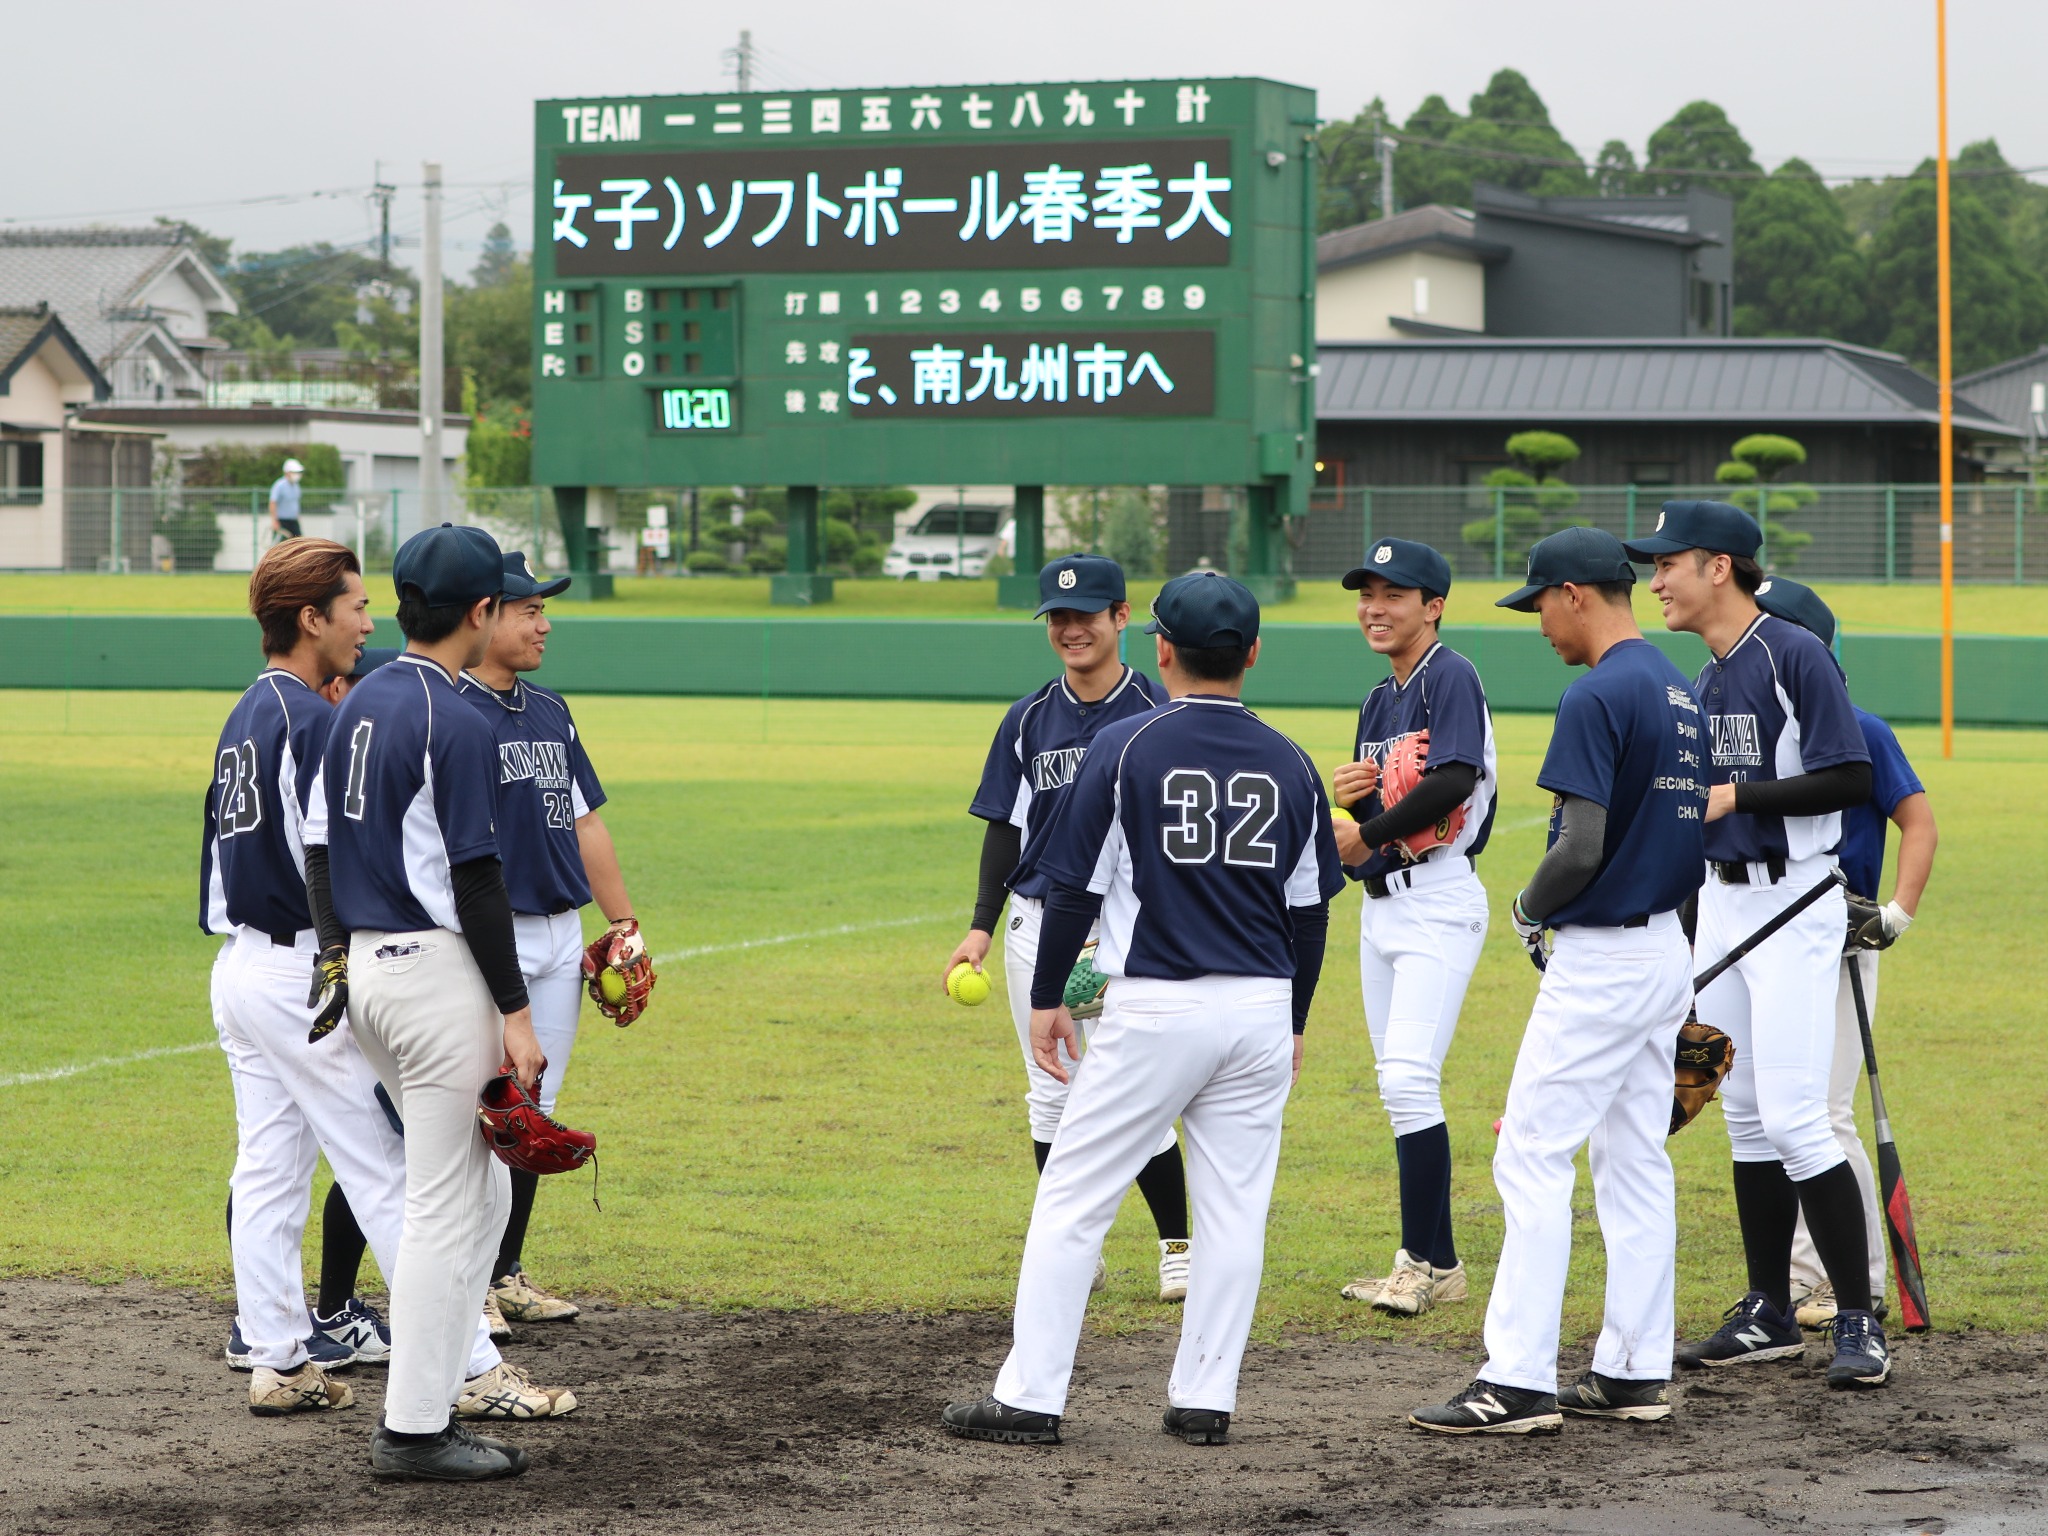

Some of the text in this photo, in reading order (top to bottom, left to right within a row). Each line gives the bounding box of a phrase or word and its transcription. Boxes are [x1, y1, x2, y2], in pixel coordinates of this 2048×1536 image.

[562, 105, 641, 143] TEAM
[761, 100, 792, 134] 三
[811, 98, 841, 133] 四
[861, 97, 892, 131] 五
[910, 94, 942, 129] 六
[961, 93, 993, 129] 七
[1010, 91, 1044, 127] 八
[1063, 89, 1095, 126] 九
[1176, 85, 1211, 123] 計
[544, 291, 565, 313] H
[624, 289, 643, 312] B
[865, 290, 878, 314] 1
[900, 289, 922, 314] 2
[938, 288, 960, 314] 3
[979, 288, 1001, 313] 4
[1020, 287, 1041, 312] 5
[1061, 287, 1083, 312] 6
[1102, 286, 1123, 311] 7
[1142, 285, 1165, 310] 8
[1183, 284, 1206, 310] 9
[545, 323, 564, 345] E
[625, 321, 644, 344] S
[344, 719, 373, 822] 1
[217, 738, 262, 841] 23
[543, 793, 574, 831] 28
[1161, 768, 1280, 869] 32
